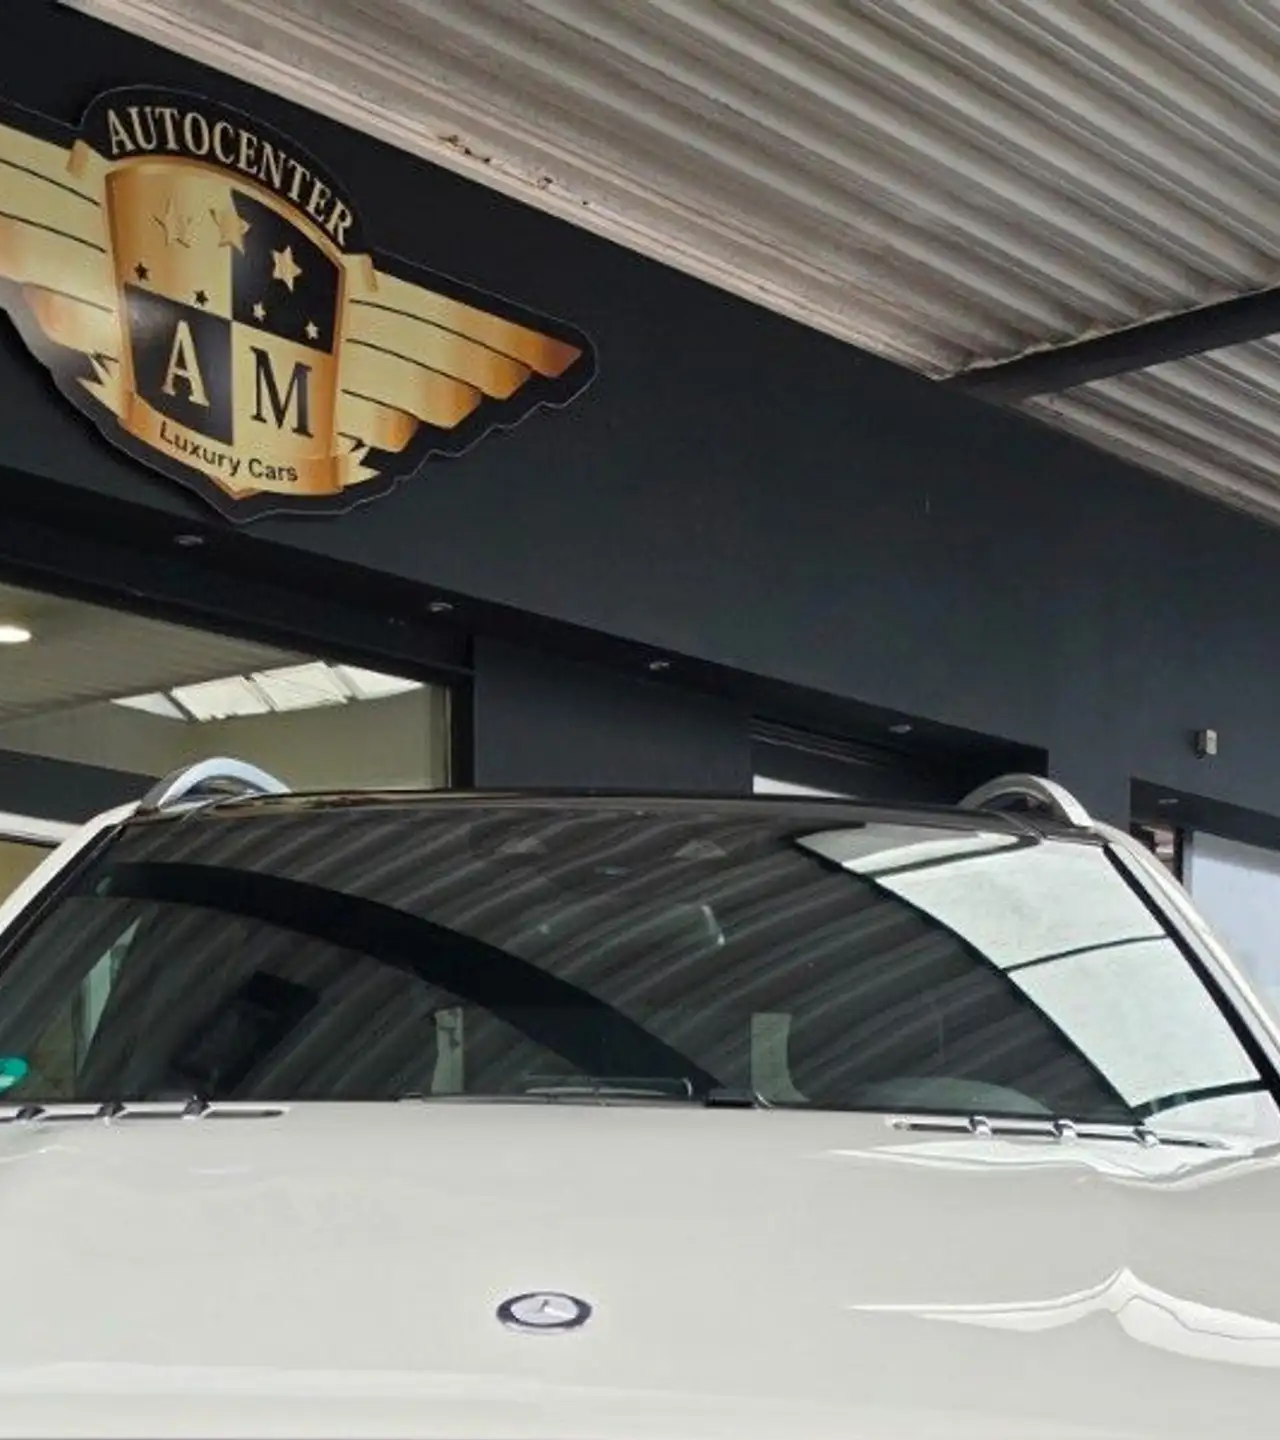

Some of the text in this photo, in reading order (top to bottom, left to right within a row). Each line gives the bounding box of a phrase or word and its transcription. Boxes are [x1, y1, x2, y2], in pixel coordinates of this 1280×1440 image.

[107, 105, 353, 246] AUTOCENTER
[161, 319, 314, 439] A M
[159, 420, 299, 482] Luxury Cars
